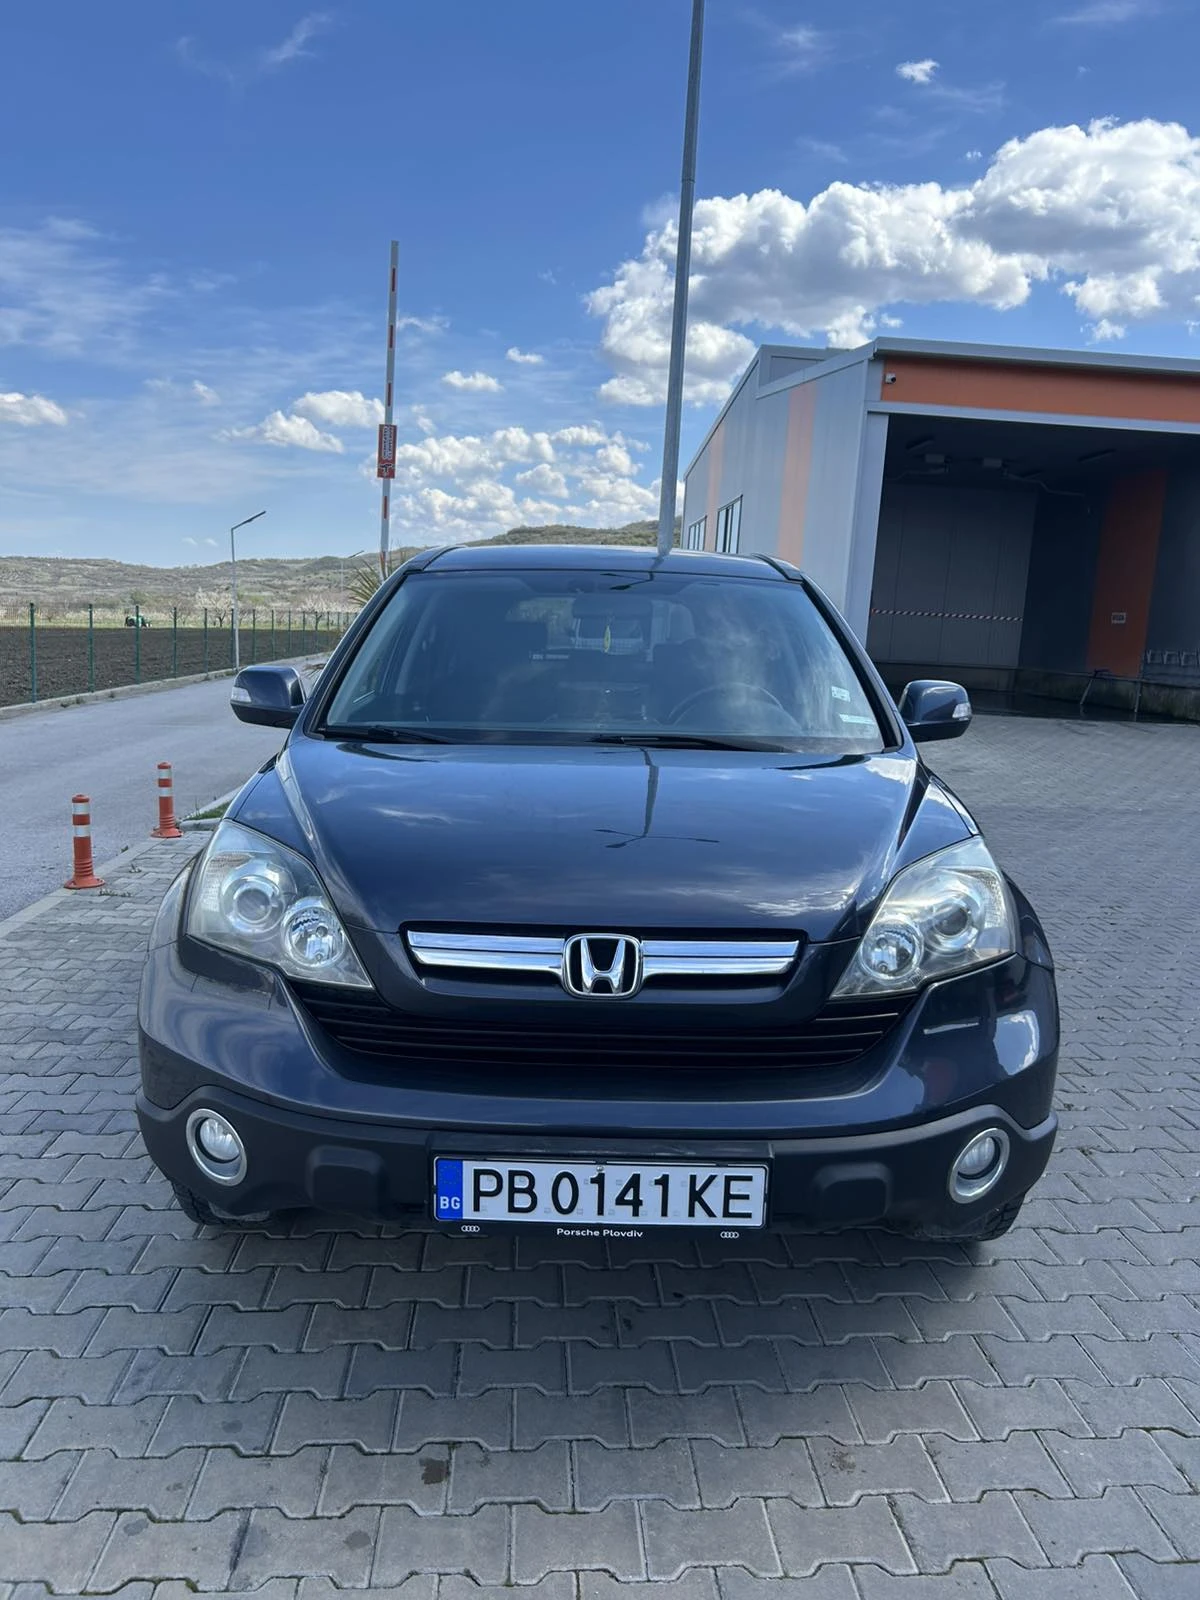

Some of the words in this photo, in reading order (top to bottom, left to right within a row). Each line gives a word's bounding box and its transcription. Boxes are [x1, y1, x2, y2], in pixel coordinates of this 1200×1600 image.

[472, 1168, 538, 1215] PB
[551, 1171, 670, 1218] 0141
[688, 1174, 754, 1219] KE
[439, 1196, 461, 1210] BG
[556, 1227, 600, 1237] Porsche
[602, 1228, 644, 1238] Plovdiv
